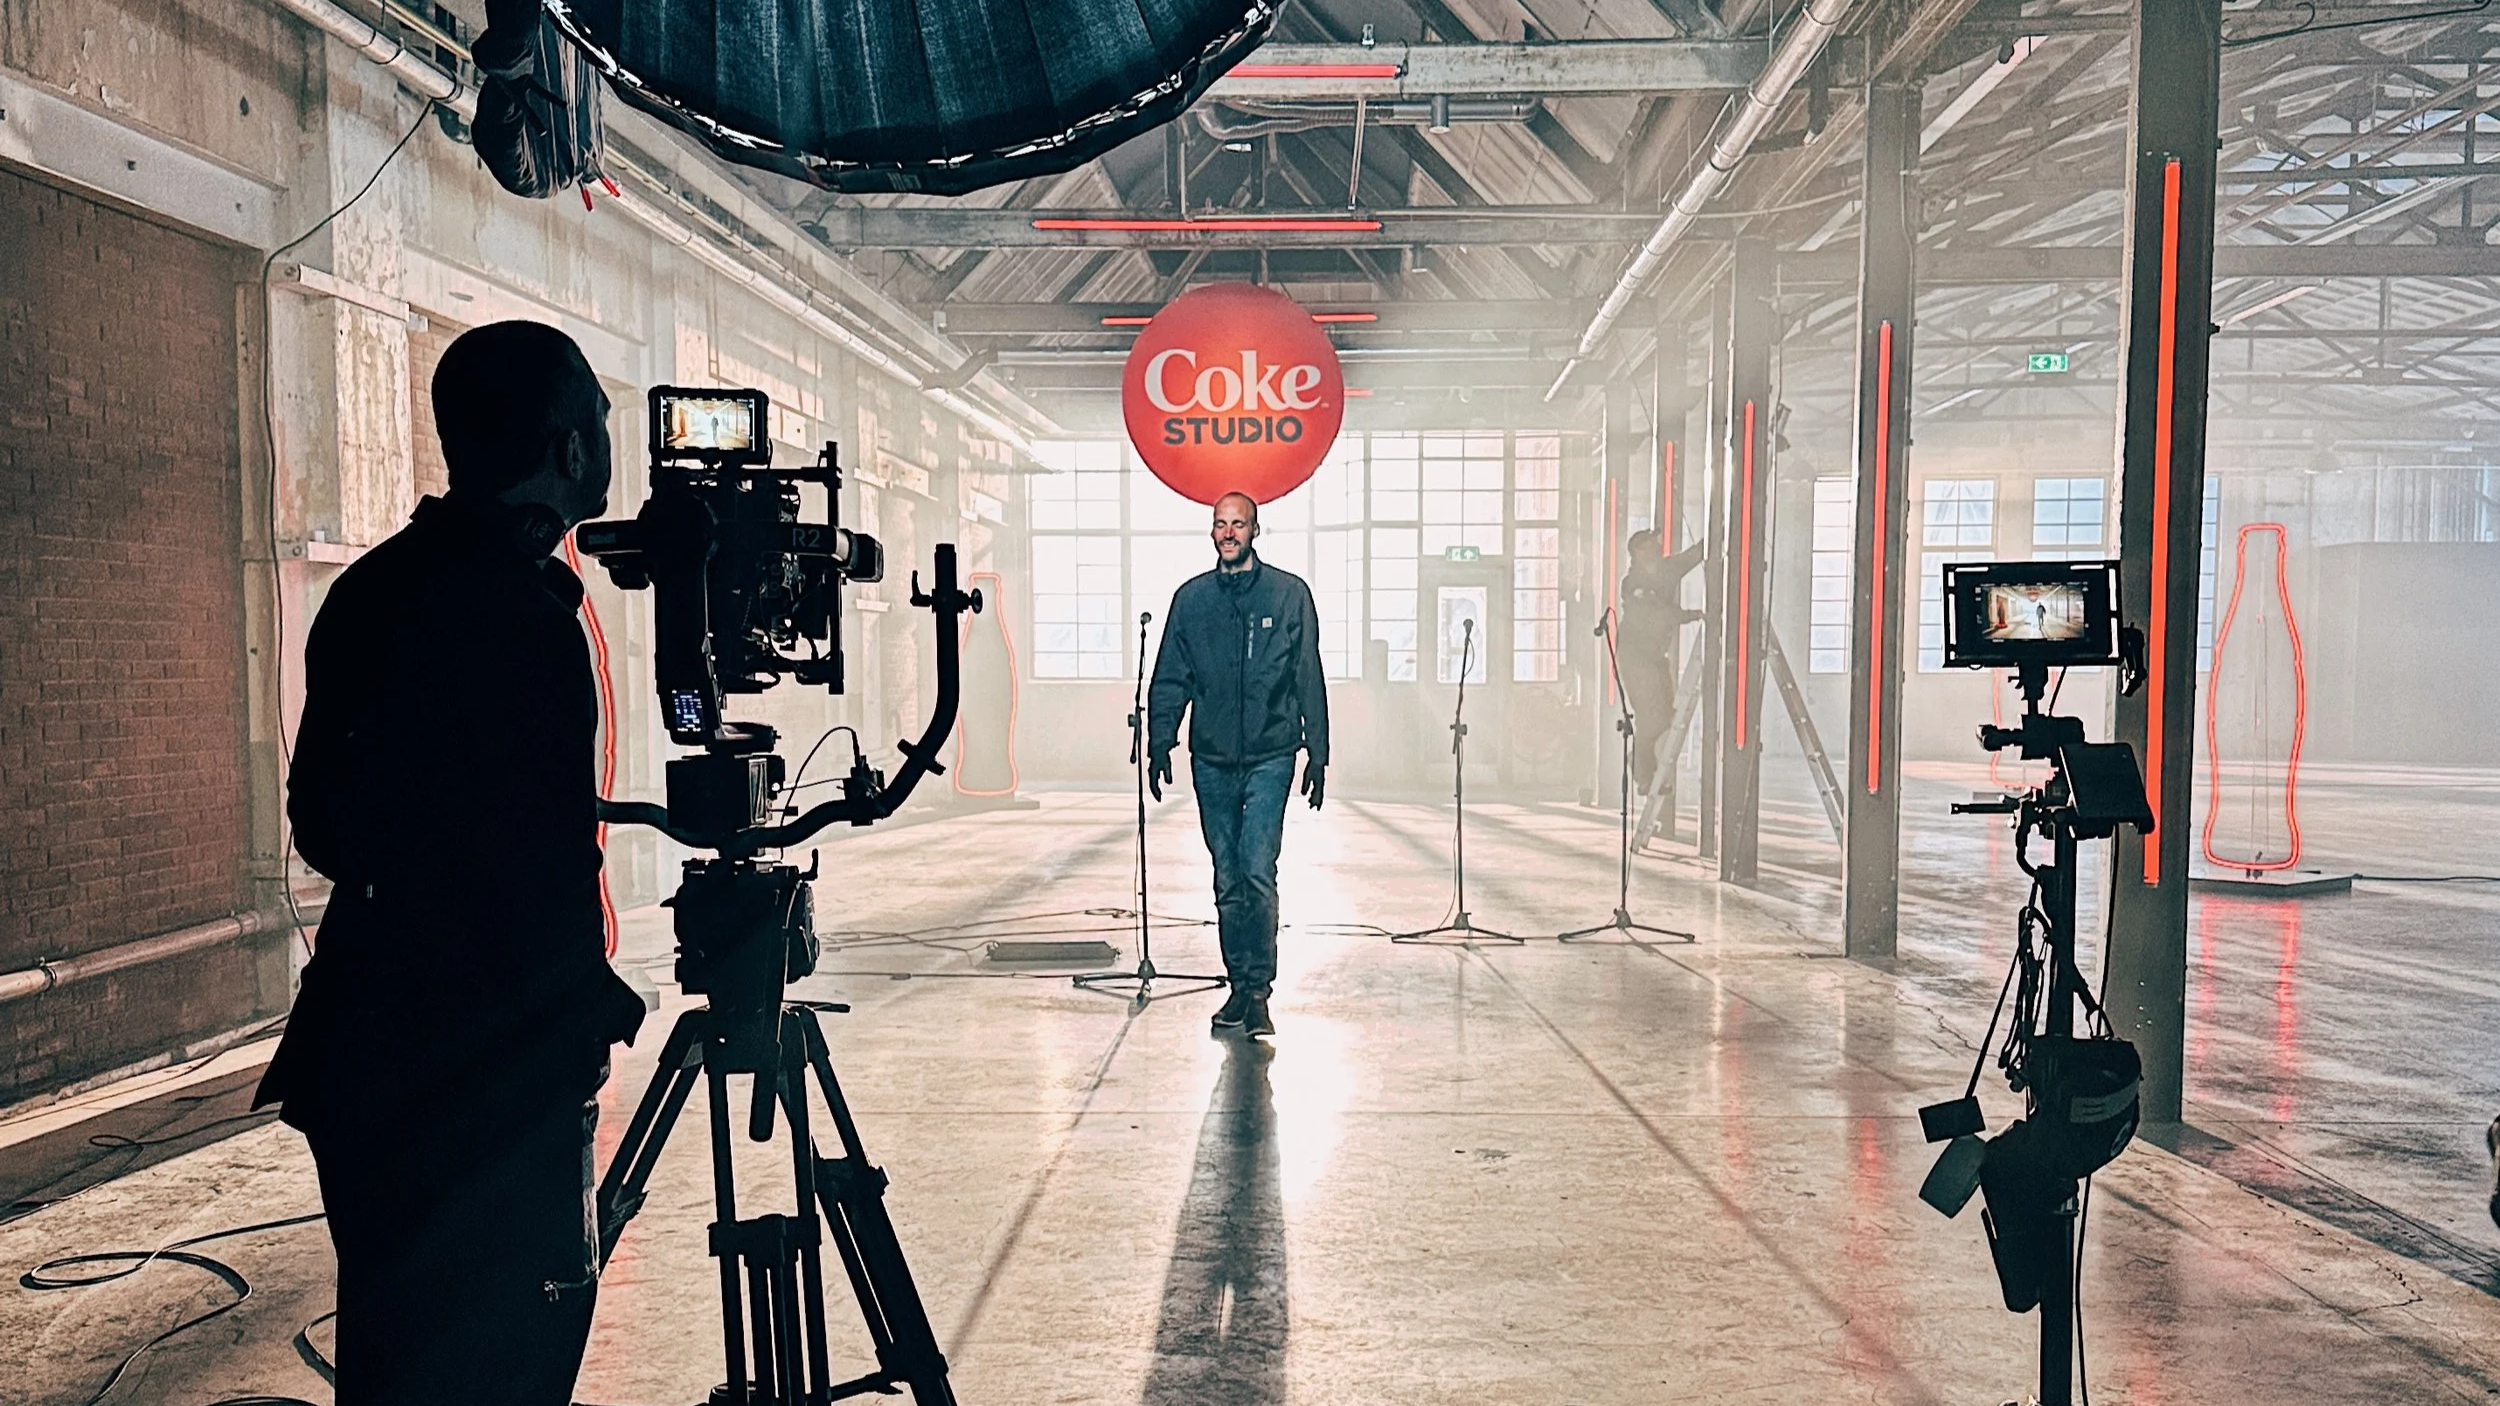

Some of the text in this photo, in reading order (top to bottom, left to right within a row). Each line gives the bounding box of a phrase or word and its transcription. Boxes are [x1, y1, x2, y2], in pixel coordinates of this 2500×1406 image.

[1144, 348, 1322, 413] Coke
[1163, 416, 1303, 445] STUDIO
[792, 528, 822, 548] R2
